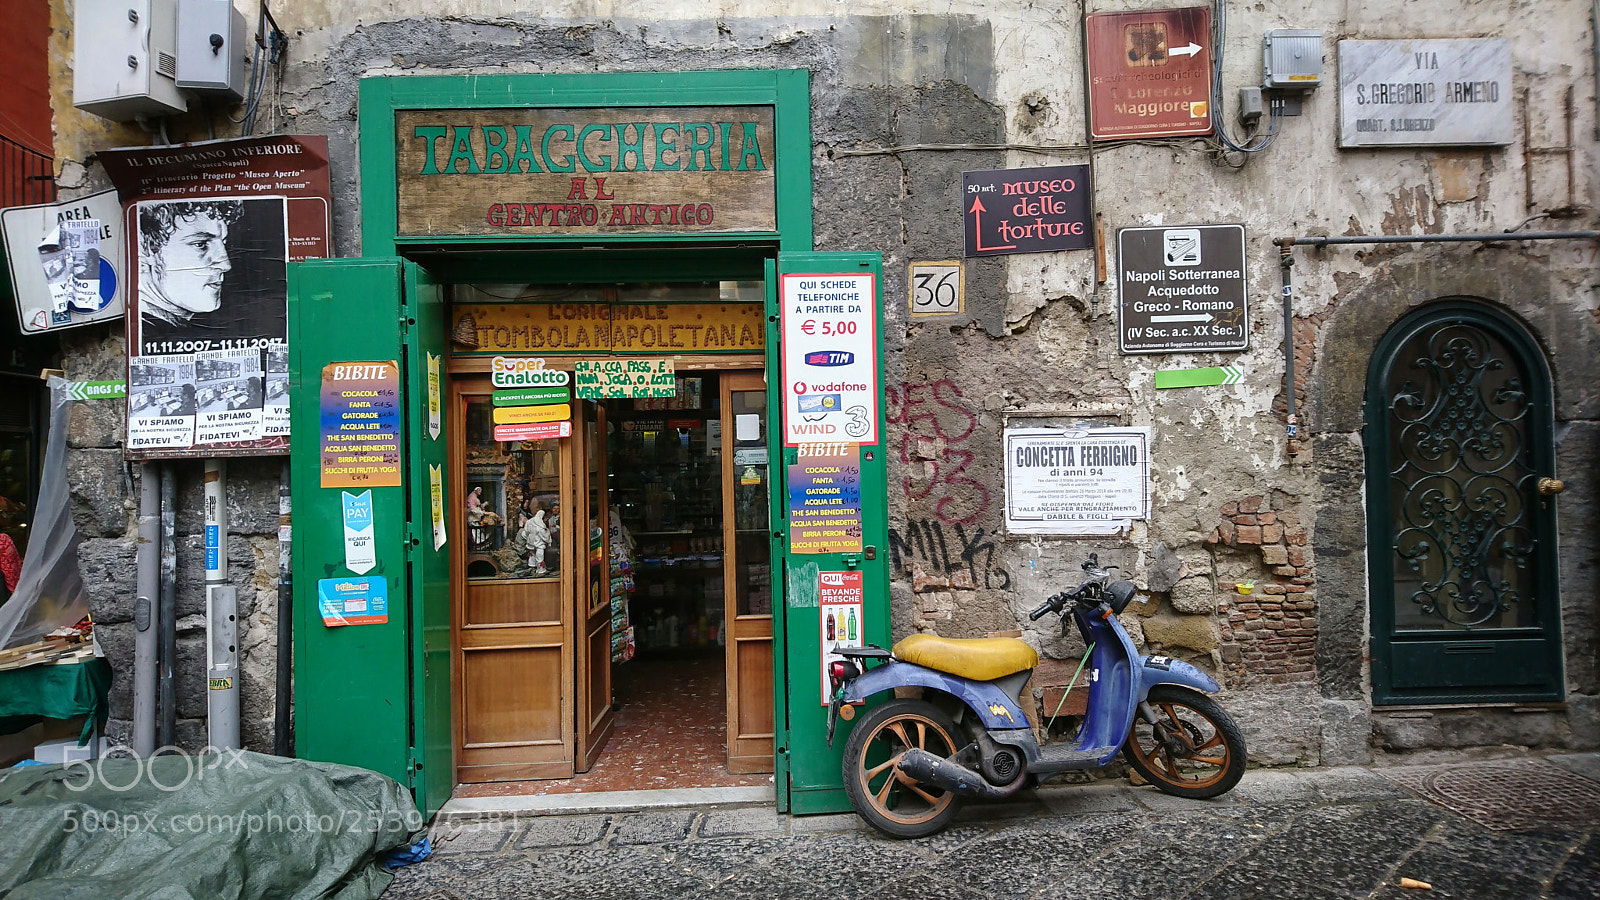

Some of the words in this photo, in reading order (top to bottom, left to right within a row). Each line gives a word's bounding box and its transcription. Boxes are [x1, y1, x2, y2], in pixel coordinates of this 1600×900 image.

[1415, 52, 1438, 70] VIA
[1445, 81, 1499, 103] ARMENO
[1114, 101, 1189, 116] Maggiore
[414, 121, 767, 175] TABACCHERIA
[127, 158, 143, 167] IL
[148, 149, 226, 166] DECUMANO
[232, 144, 303, 157] INFERIORE
[202, 171, 236, 181] Progetto
[154, 184, 185, 195] Itinerary
[189, 184, 198, 193] of
[200, 184, 211, 192] the
[214, 183, 231, 192] Plan
[252, 181, 271, 192] Open
[567, 177, 615, 201] AL
[967, 184, 980, 194] 50
[1012, 195, 1066, 217] delle
[57, 206, 91, 223] AREA
[68, 220, 99, 229] FRATELLO
[998, 217, 1084, 243] torture
[1126, 269, 1165, 283] Napoli
[1169, 268, 1240, 281] Sotterranea
[799, 281, 816, 291] QUI
[820, 281, 857, 289] SCHEDE
[914, 270, 958, 307] 36
[797, 293, 860, 302] TELEFONICHE
[1147, 285, 1220, 299] Acquedotto
[795, 305, 802, 314] A
[806, 305, 844, 314] PARTIRE
[848, 305, 862, 313] DA
[1134, 301, 1171, 313] Greco
[1182, 300, 1234, 311] Romano
[822, 321, 857, 337] 5,00
[1145, 326, 1170, 338] Sec.
[1193, 325, 1209, 336] XX
[475, 324, 590, 349] TOMBOLA
[132, 357, 158, 365] GRANDE
[163, 355, 195, 363] FRATELLO
[196, 352, 223, 360] GRANDE
[227, 349, 259, 357] FRATELLO
[829, 353, 850, 364] TIM
[243, 358, 259, 373] 1984
[494, 359, 542, 373] Super
[333, 365, 389, 381] BIBITE
[495, 371, 566, 385] Enalotto
[87, 385, 112, 395] BAGS
[811, 381, 868, 392] vodafone
[341, 390, 379, 398] COCACOLA
[206, 413, 215, 421] VI
[217, 411, 252, 420] SPIAMO
[342, 412, 379, 420] GATORADE
[150, 418, 184, 426] SPIAMO
[340, 423, 363, 431] ACQUA
[792, 424, 836, 435] WIND
[132, 437, 170, 446] FIDATEVI
[200, 432, 240, 440] FIDATEVI
[798, 442, 849, 457] BIBITE
[337, 455, 357, 463] BIRRA
[359, 455, 383, 463] PERONI
[1016, 446, 1075, 467] CONCETTA
[1080, 445, 1138, 467] FERRIGNO
[804, 466, 841, 474] COCACOLA
[1050, 468, 1060, 477] di
[1063, 468, 1087, 477] anni
[1090, 468, 1104, 477] 94
[347, 507, 369, 519] PAY
[805, 509, 819, 517] SAN
[820, 508, 856, 516] BENEDETTO
[789, 520, 811, 528] ACQUA
[825, 519, 858, 527] BENEDETTO
[802, 531, 821, 539] BIRRA
[822, 530, 846, 538] PERONI
[823, 574, 840, 583] QUI
[821, 588, 861, 596] BEVANDE
[822, 595, 860, 603] FRESCHE
